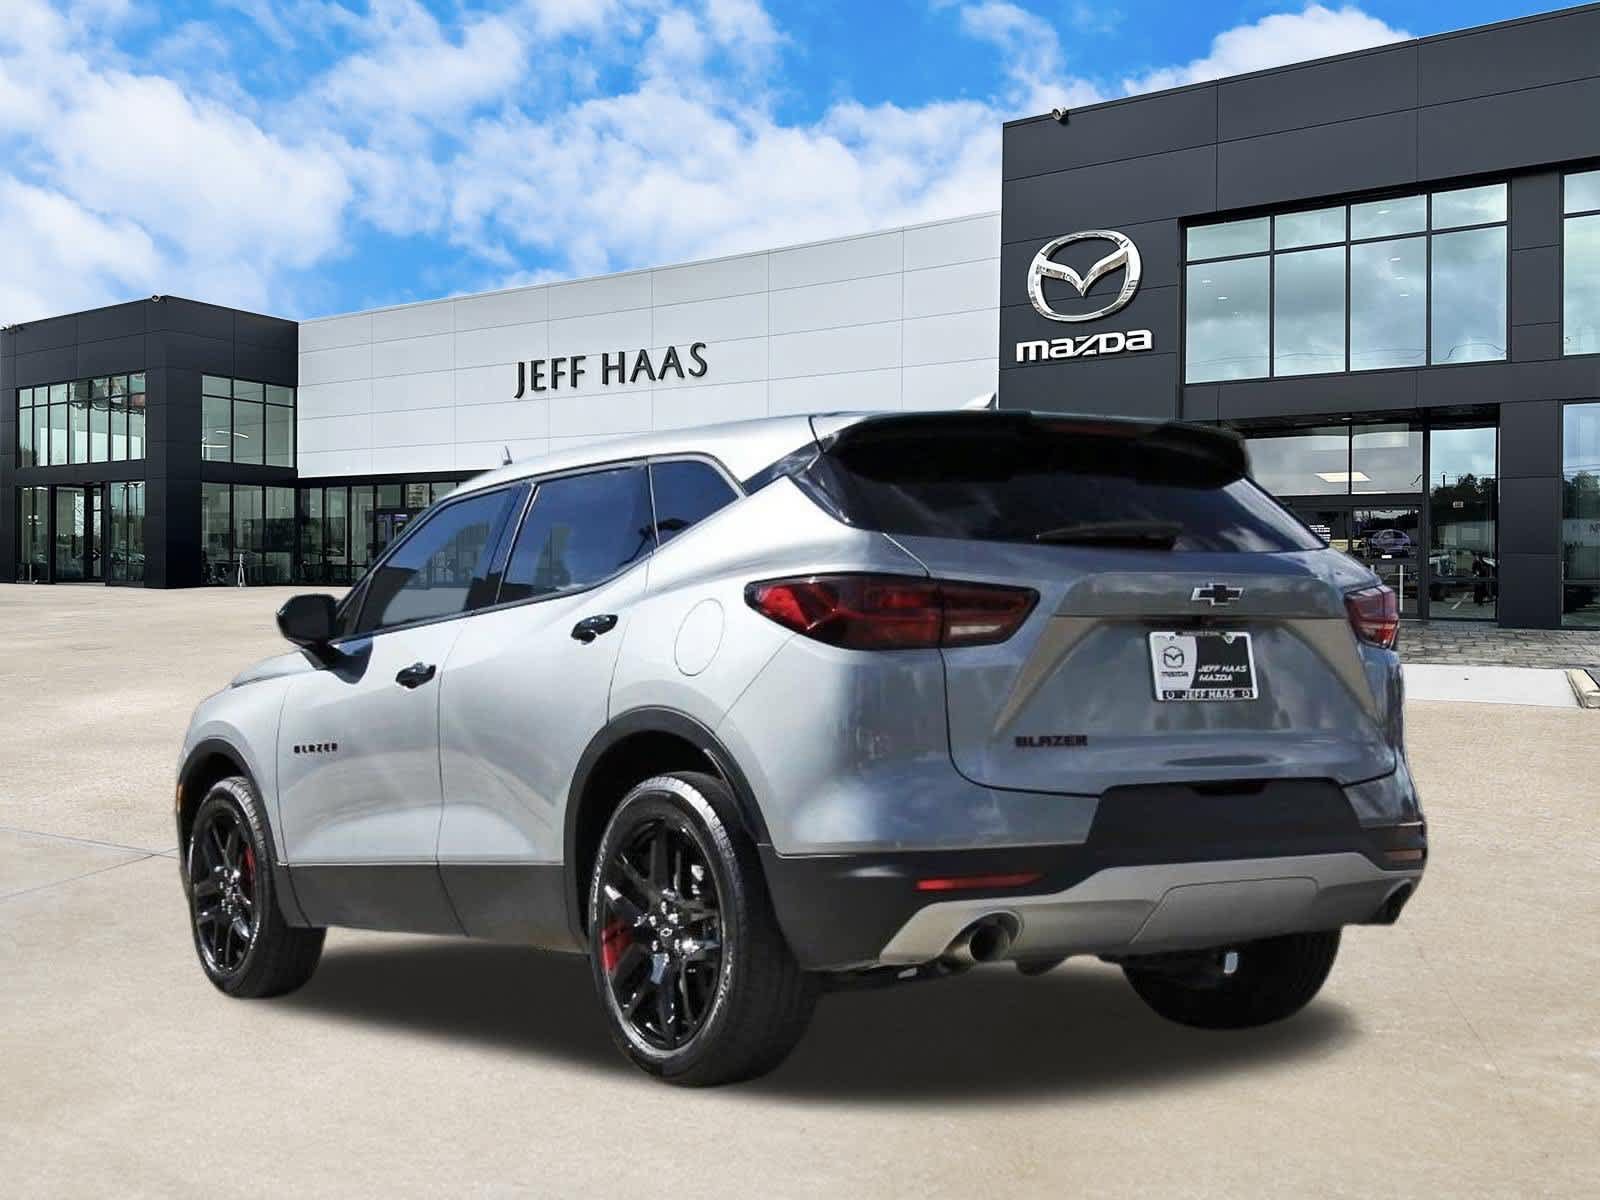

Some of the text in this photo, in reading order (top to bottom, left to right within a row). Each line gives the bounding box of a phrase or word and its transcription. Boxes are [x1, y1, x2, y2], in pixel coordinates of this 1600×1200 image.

[513, 342, 708, 400] JEFF HAAS
[1182, 689, 1235, 700] JEFF HAAS
[1015, 735, 1088, 747] BLAZER
[294, 743, 337, 753] BLAZER
